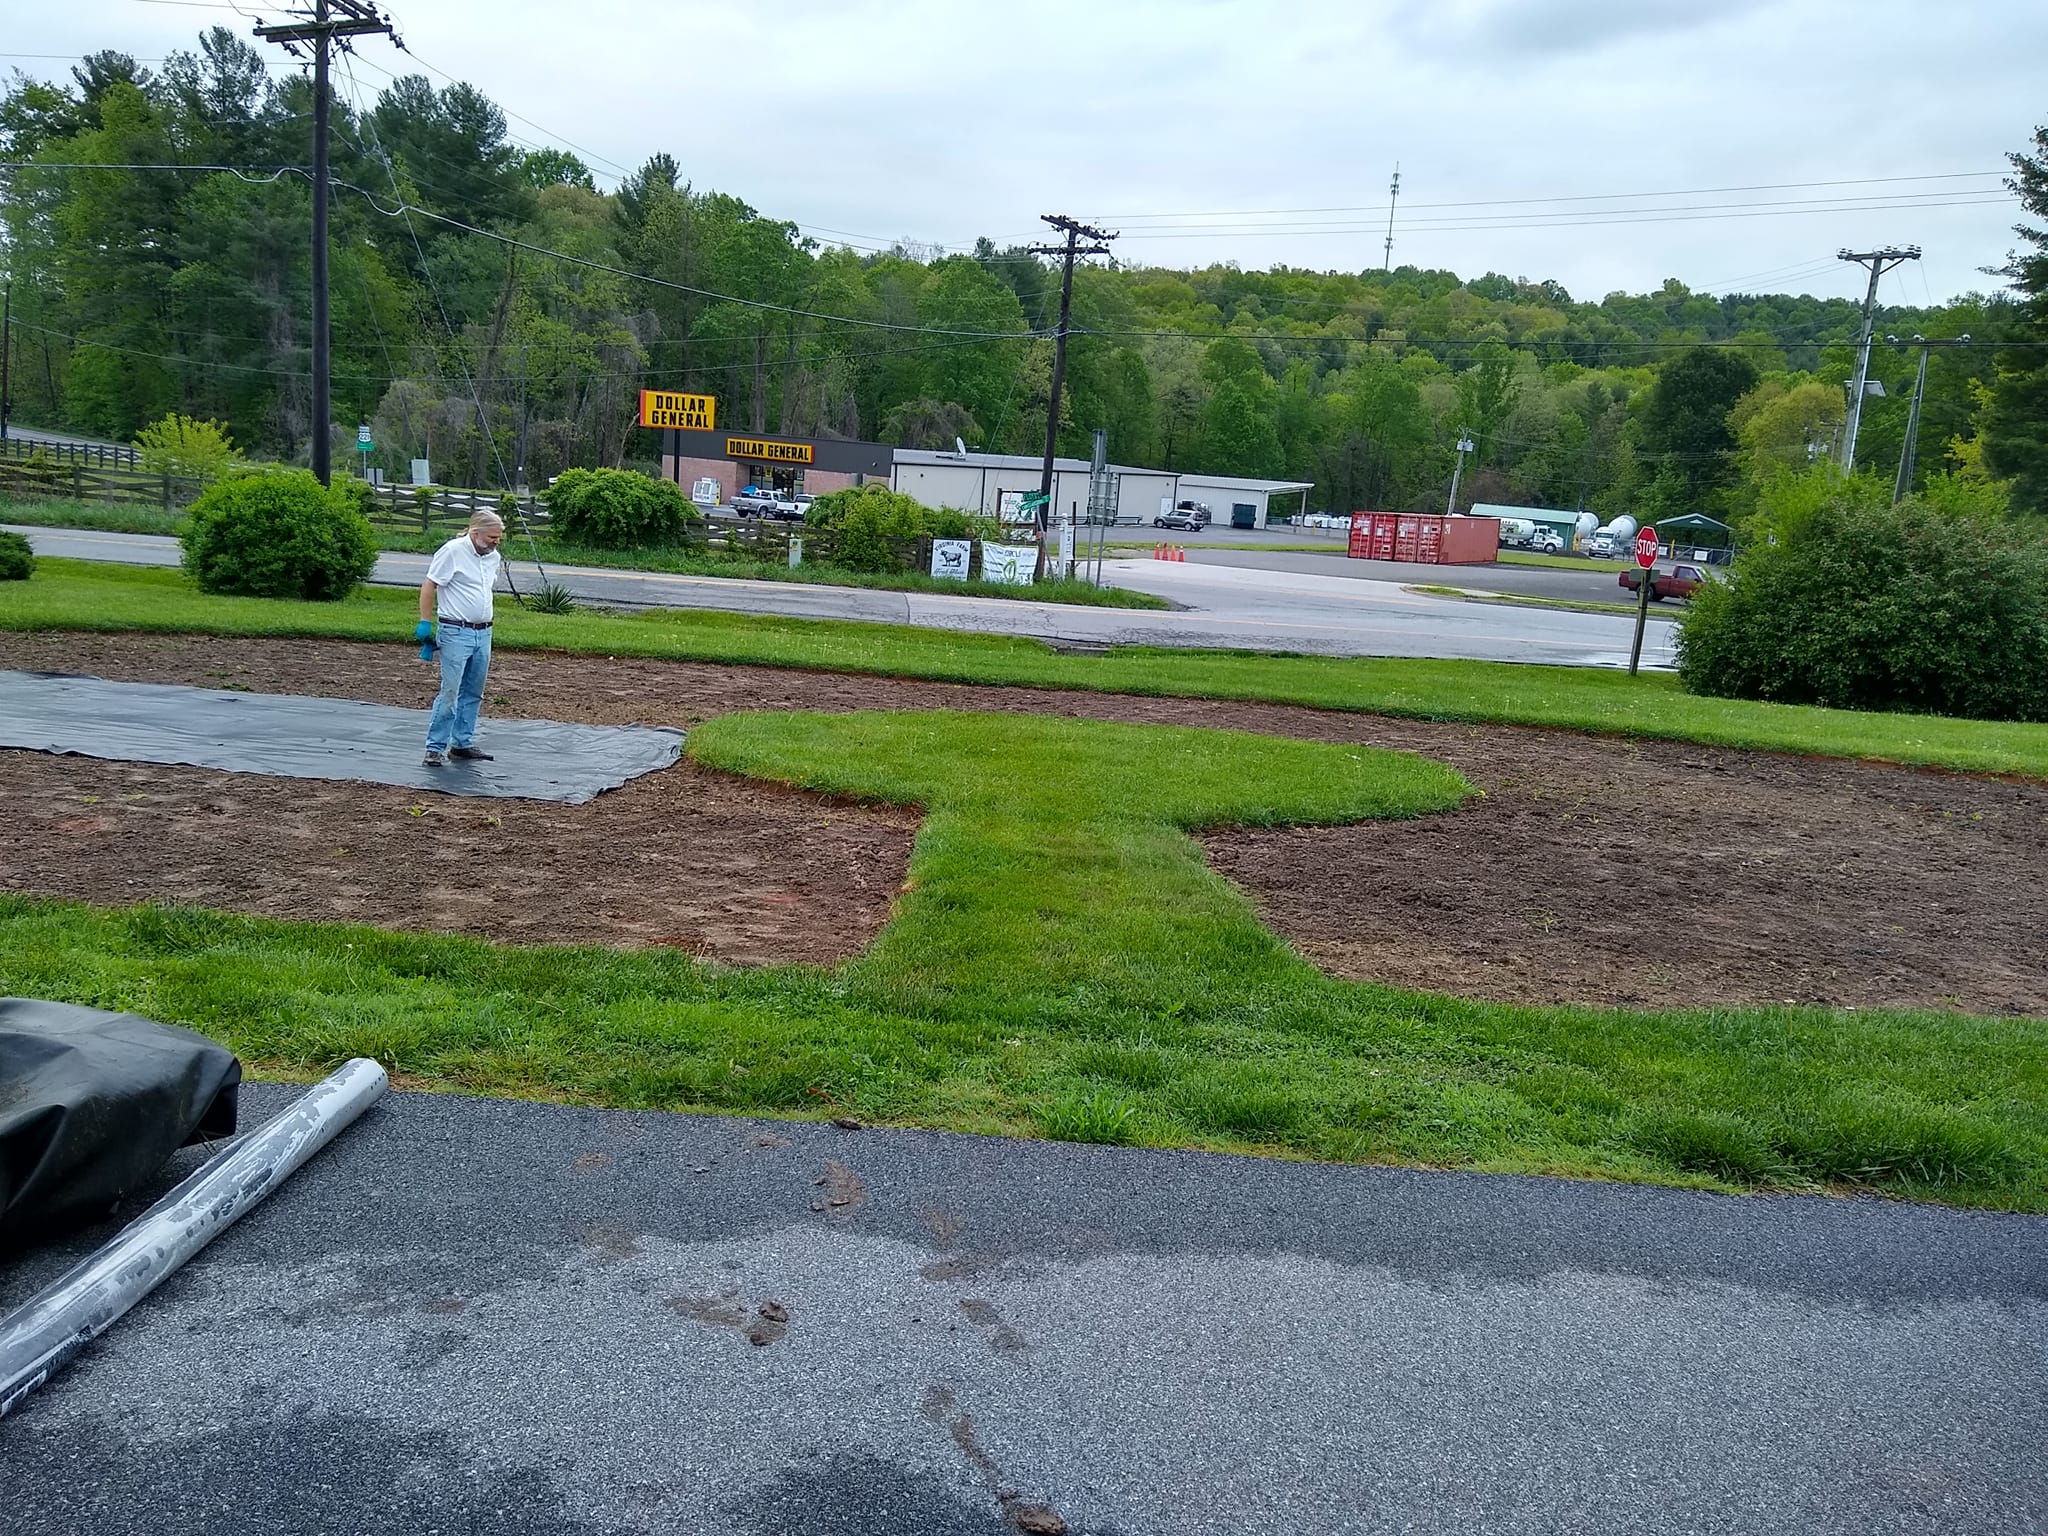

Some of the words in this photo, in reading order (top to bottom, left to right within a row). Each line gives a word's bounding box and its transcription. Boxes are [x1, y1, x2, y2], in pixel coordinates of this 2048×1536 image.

[656, 395, 705, 412] DOLLAR
[652, 410, 709, 428] GENERAL
[730, 441, 764, 456] DOLLAR
[768, 445, 809, 461] GENERAL
[957, 542, 969, 552] FARM
[1637, 539, 1657, 557] STOP
